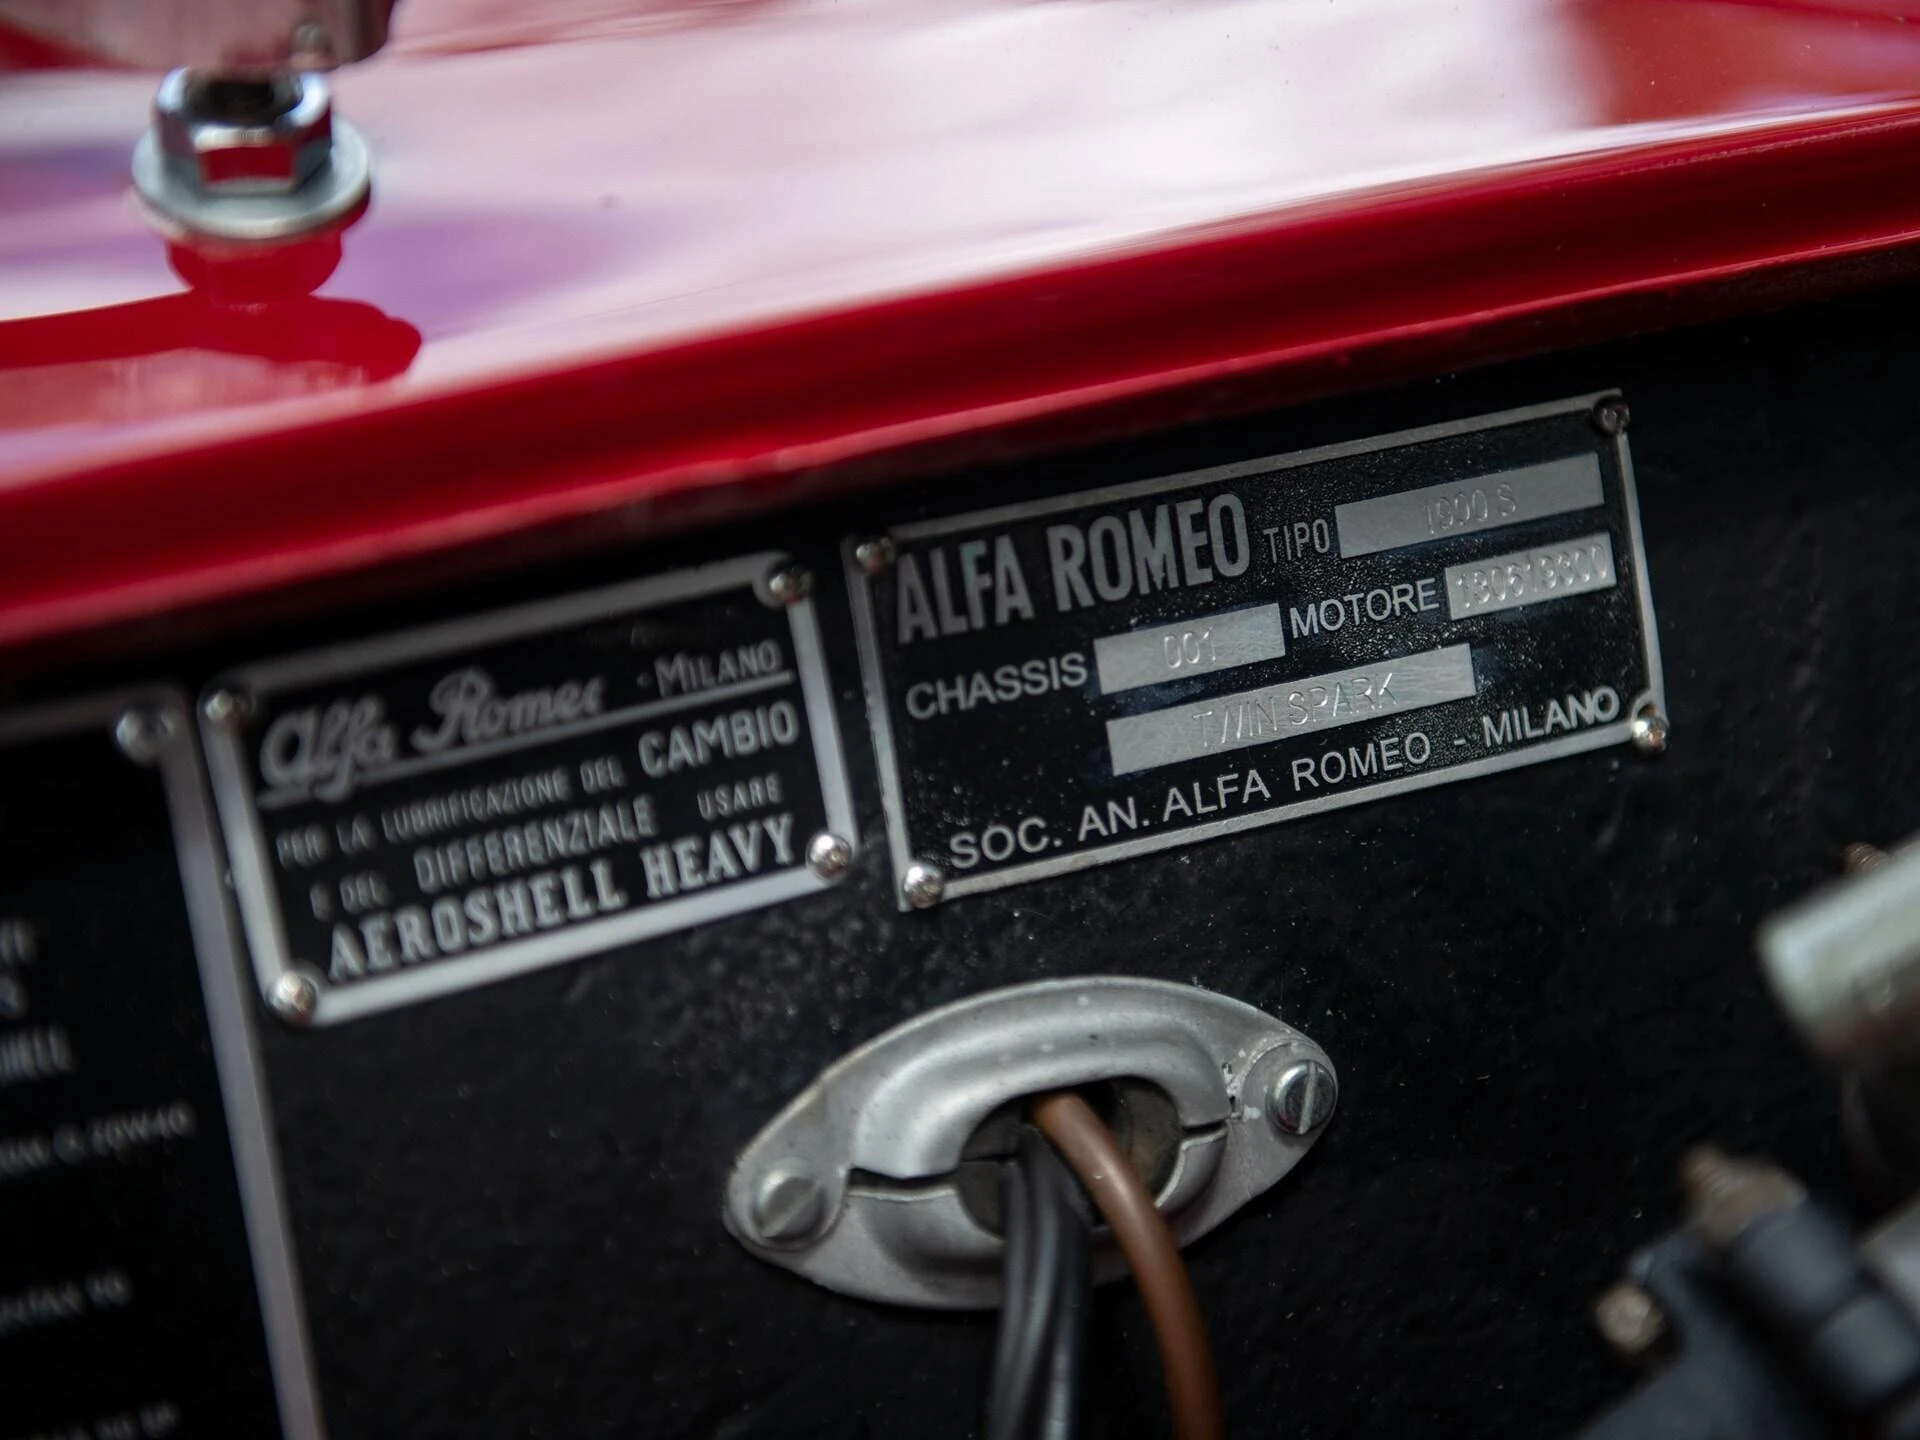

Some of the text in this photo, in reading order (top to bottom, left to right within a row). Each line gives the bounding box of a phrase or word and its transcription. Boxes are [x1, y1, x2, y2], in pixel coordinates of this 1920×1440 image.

[897, 493, 1251, 644] ALFA ROMEO
[1262, 518, 1331, 564] TIPO
[1499, 482, 1517, 517] S
[905, 627, 1219, 720] CHASSIS 001
[1290, 578, 1441, 639] MOTORE
[259, 696, 397, 800] Alfa
[654, 639, 783, 697] MILANO
[381, 765, 572, 843] LUBRIFICAZIONE
[579, 755, 627, 794] DEL
[638, 700, 799, 778] CAMBIO
[1192, 671, 1400, 749] TWIN SPARK
[413, 794, 657, 895] DIFFERENZIALE
[697, 771, 783, 821] USARE
[949, 817, 1062, 871] SOC.
[1077, 797, 1149, 844] AN.
[1163, 768, 1271, 823] ALFA
[1292, 731, 1431, 791] ROMEO
[1482, 684, 1621, 750] MILANO
[328, 812, 795, 983] AEROSHELL HEAVY
